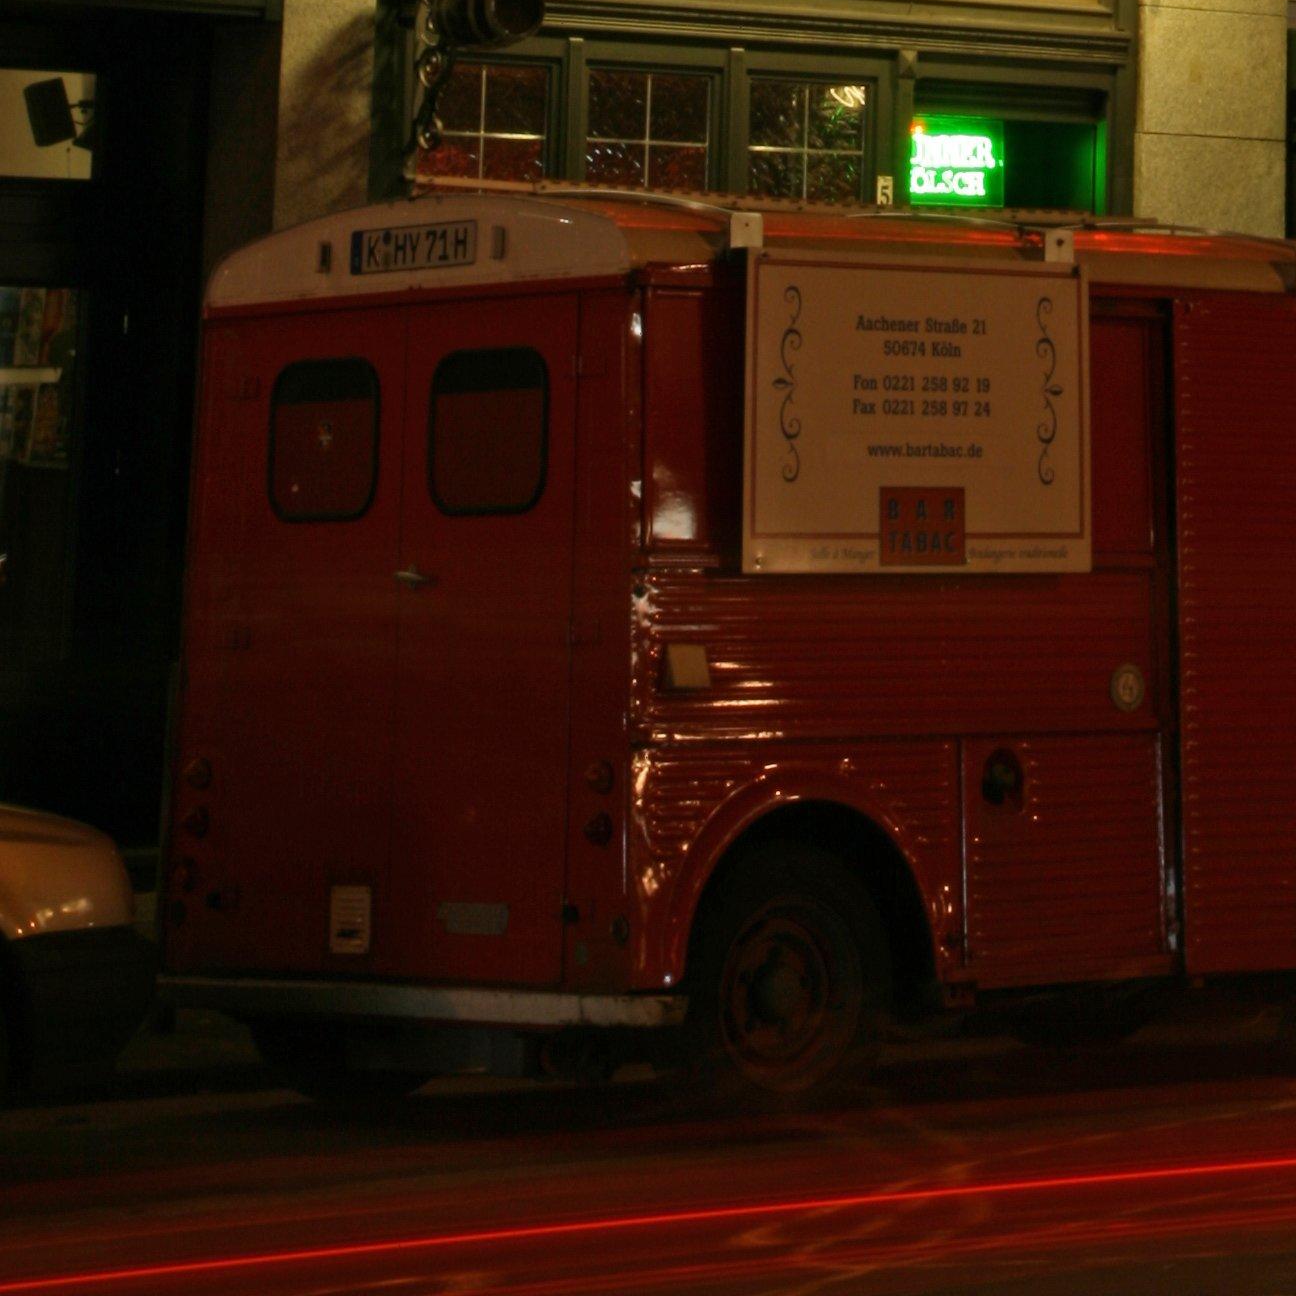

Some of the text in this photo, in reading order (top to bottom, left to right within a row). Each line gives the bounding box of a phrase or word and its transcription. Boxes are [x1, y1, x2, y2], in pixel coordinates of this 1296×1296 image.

[855, 315, 987, 335] Aachener Straße 21
[883, 340, 962, 357] 50674 Köln
[853, 374, 991, 394] Fon 0221 258 92 19
[853, 398, 991, 417] Fax 0221 258 97 24
[867, 442, 983, 458] www.bartabac.de
[887, 531, 957, 553] TABAC
